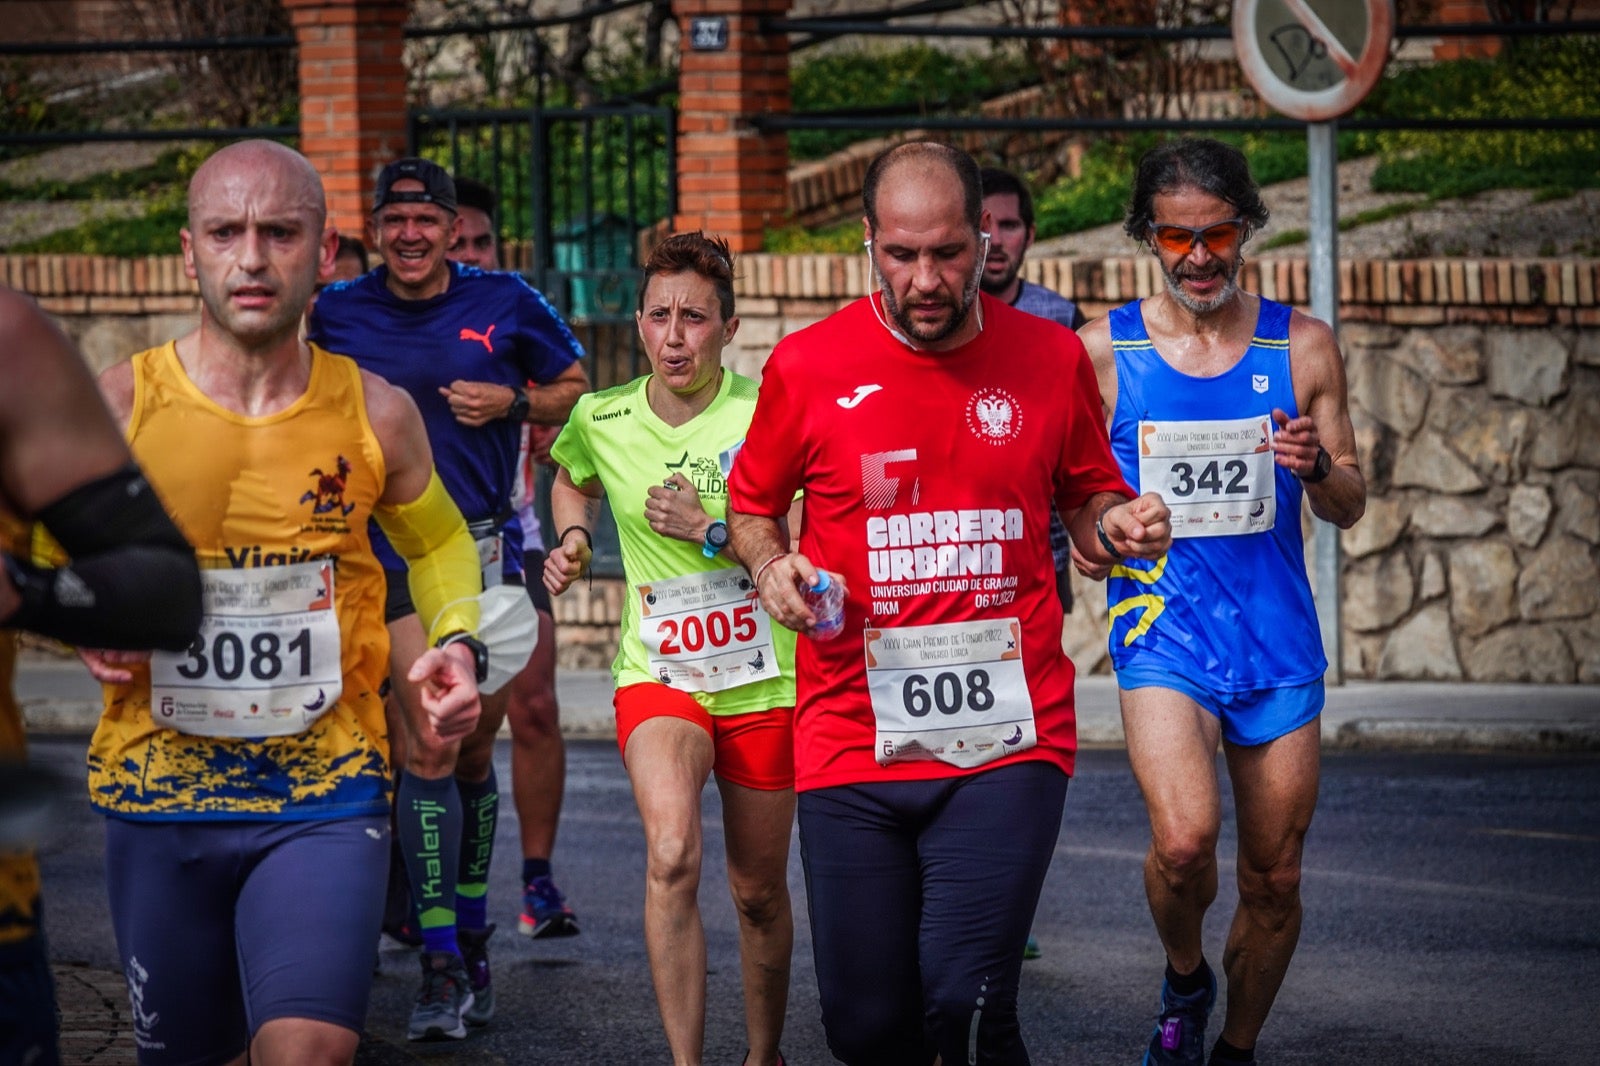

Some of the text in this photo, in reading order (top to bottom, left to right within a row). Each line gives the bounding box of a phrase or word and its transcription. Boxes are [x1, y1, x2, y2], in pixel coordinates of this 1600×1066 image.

[592, 409, 622, 422] luanvi
[697, 478, 728, 494] LIDE
[1170, 459, 1249, 497] 342
[866, 508, 1024, 549] CARRERA
[868, 542, 1003, 583] URBANA
[870, 581, 932, 598] UNIVERSIDAD
[932, 579, 969, 593] CIUDAD
[970, 578, 982, 591] DE
[872, 600, 899, 615] 10KM
[656, 603, 757, 655] 2005
[922, 635, 949, 648] PREMIO
[984, 629, 1003, 642] 2022
[176, 628, 312, 681] 3081
[902, 668, 995, 718] 608
